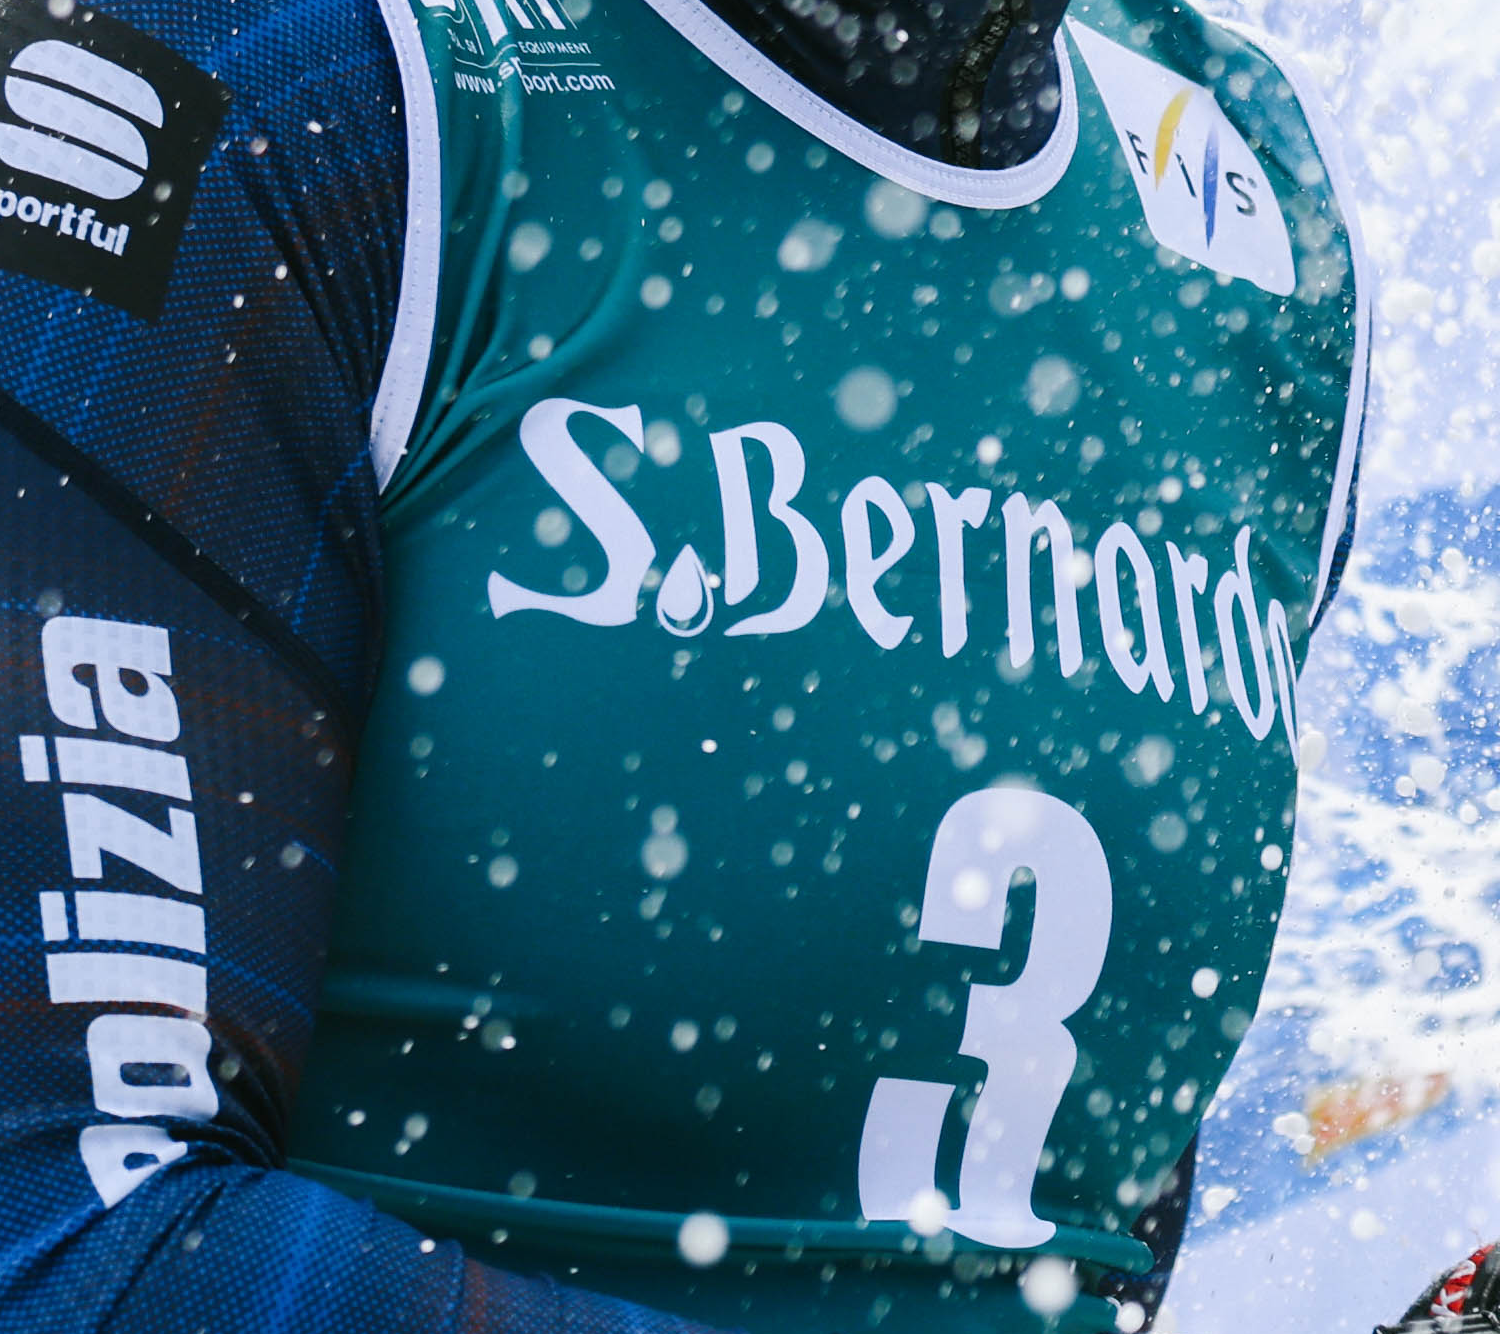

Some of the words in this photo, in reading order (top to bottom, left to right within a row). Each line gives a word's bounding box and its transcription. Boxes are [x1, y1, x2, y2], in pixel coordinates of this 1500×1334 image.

[517, 40, 593, 56] EQUIPMENT
[1125, 129, 1258, 217] FIS
[857, 787, 1114, 1249] 3
